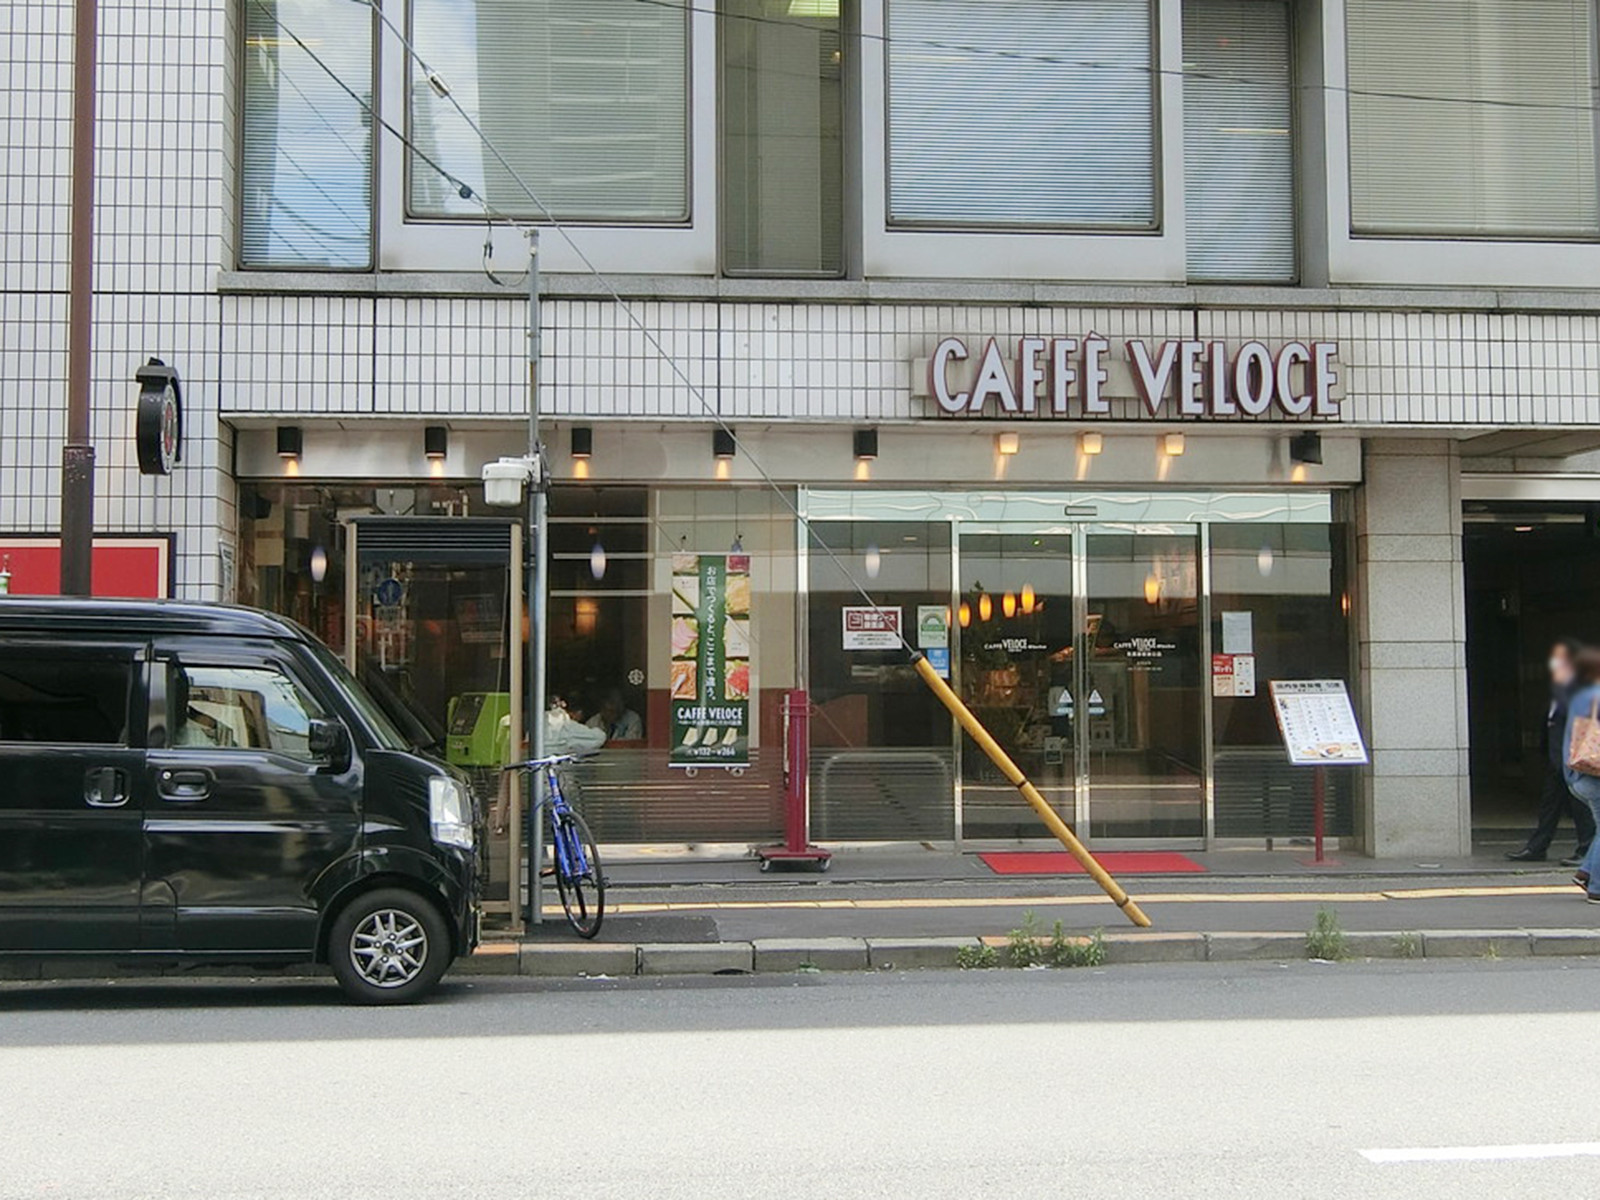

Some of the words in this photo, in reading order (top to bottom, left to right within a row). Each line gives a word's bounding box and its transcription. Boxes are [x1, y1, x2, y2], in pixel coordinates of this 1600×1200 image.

[932, 331, 1110, 414] CAFFÈ
[1126, 340, 1340, 416] VELOCE
[708, 706, 743, 720] VELOCE
